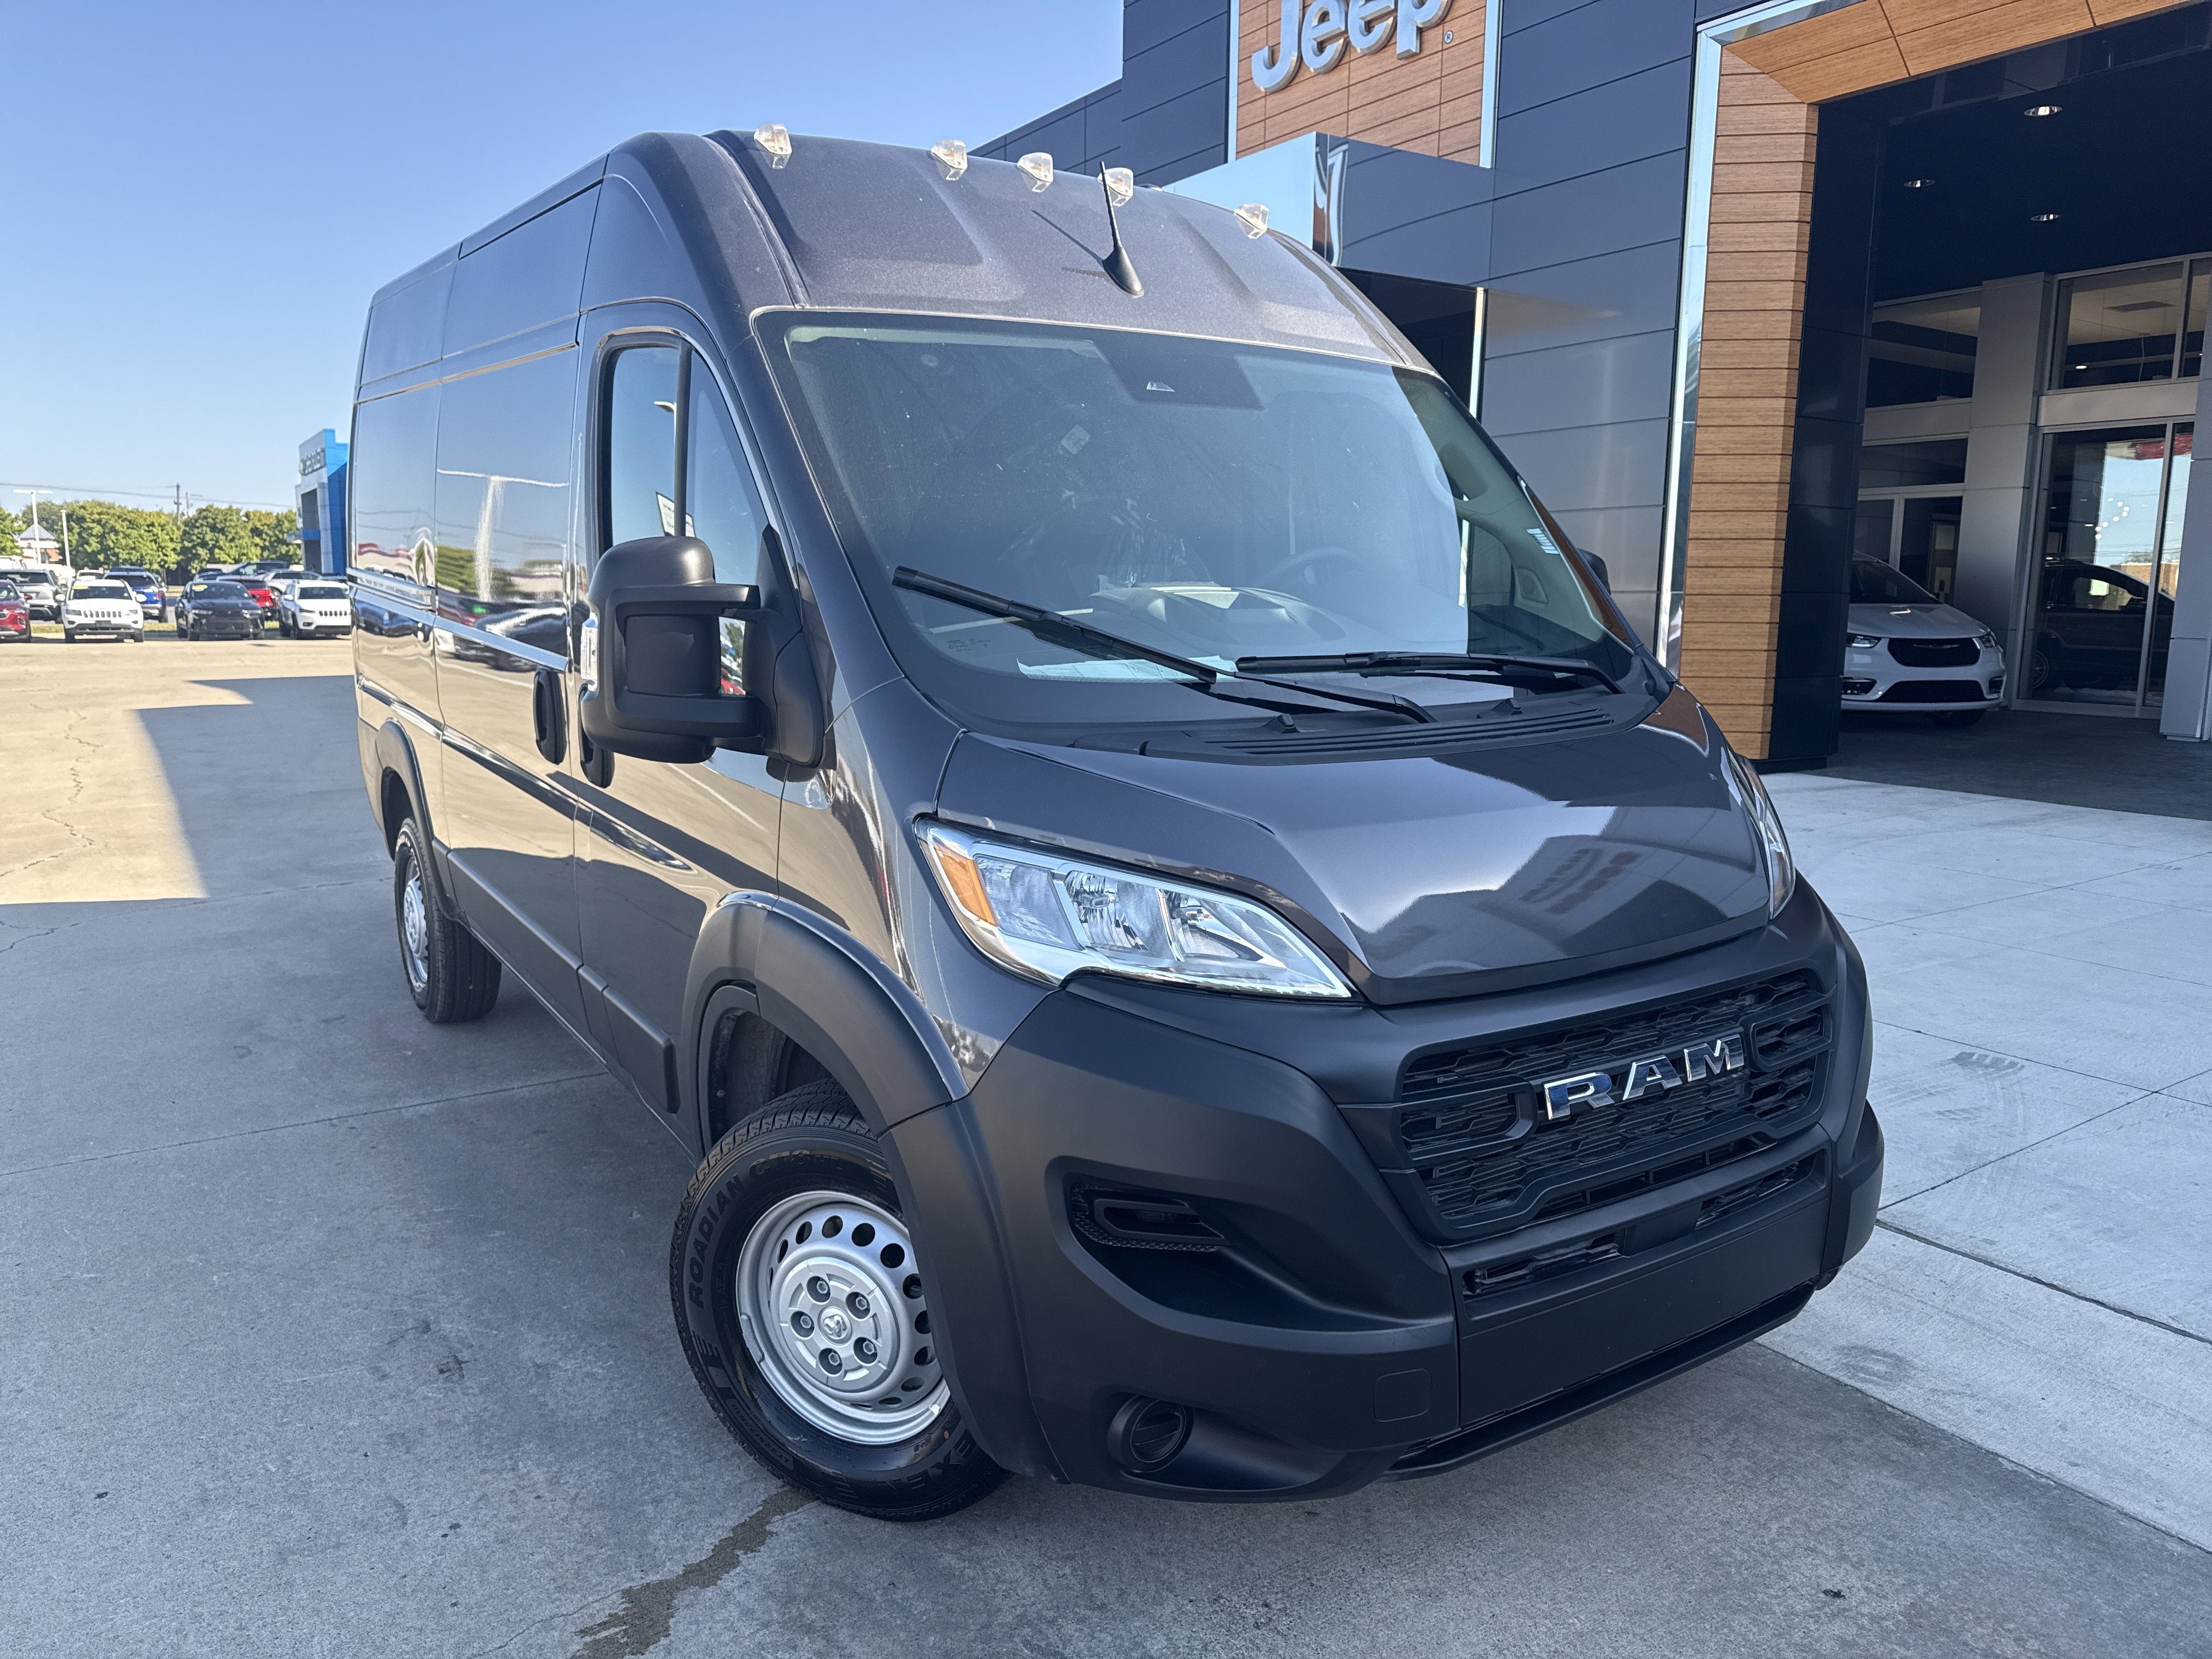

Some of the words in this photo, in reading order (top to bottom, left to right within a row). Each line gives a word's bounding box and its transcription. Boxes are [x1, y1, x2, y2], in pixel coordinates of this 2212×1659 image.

[1251, 0, 1452, 92] Jeep
[1544, 1034, 1745, 1120] RAM
[689, 1172, 746, 1310] ROADIAN
